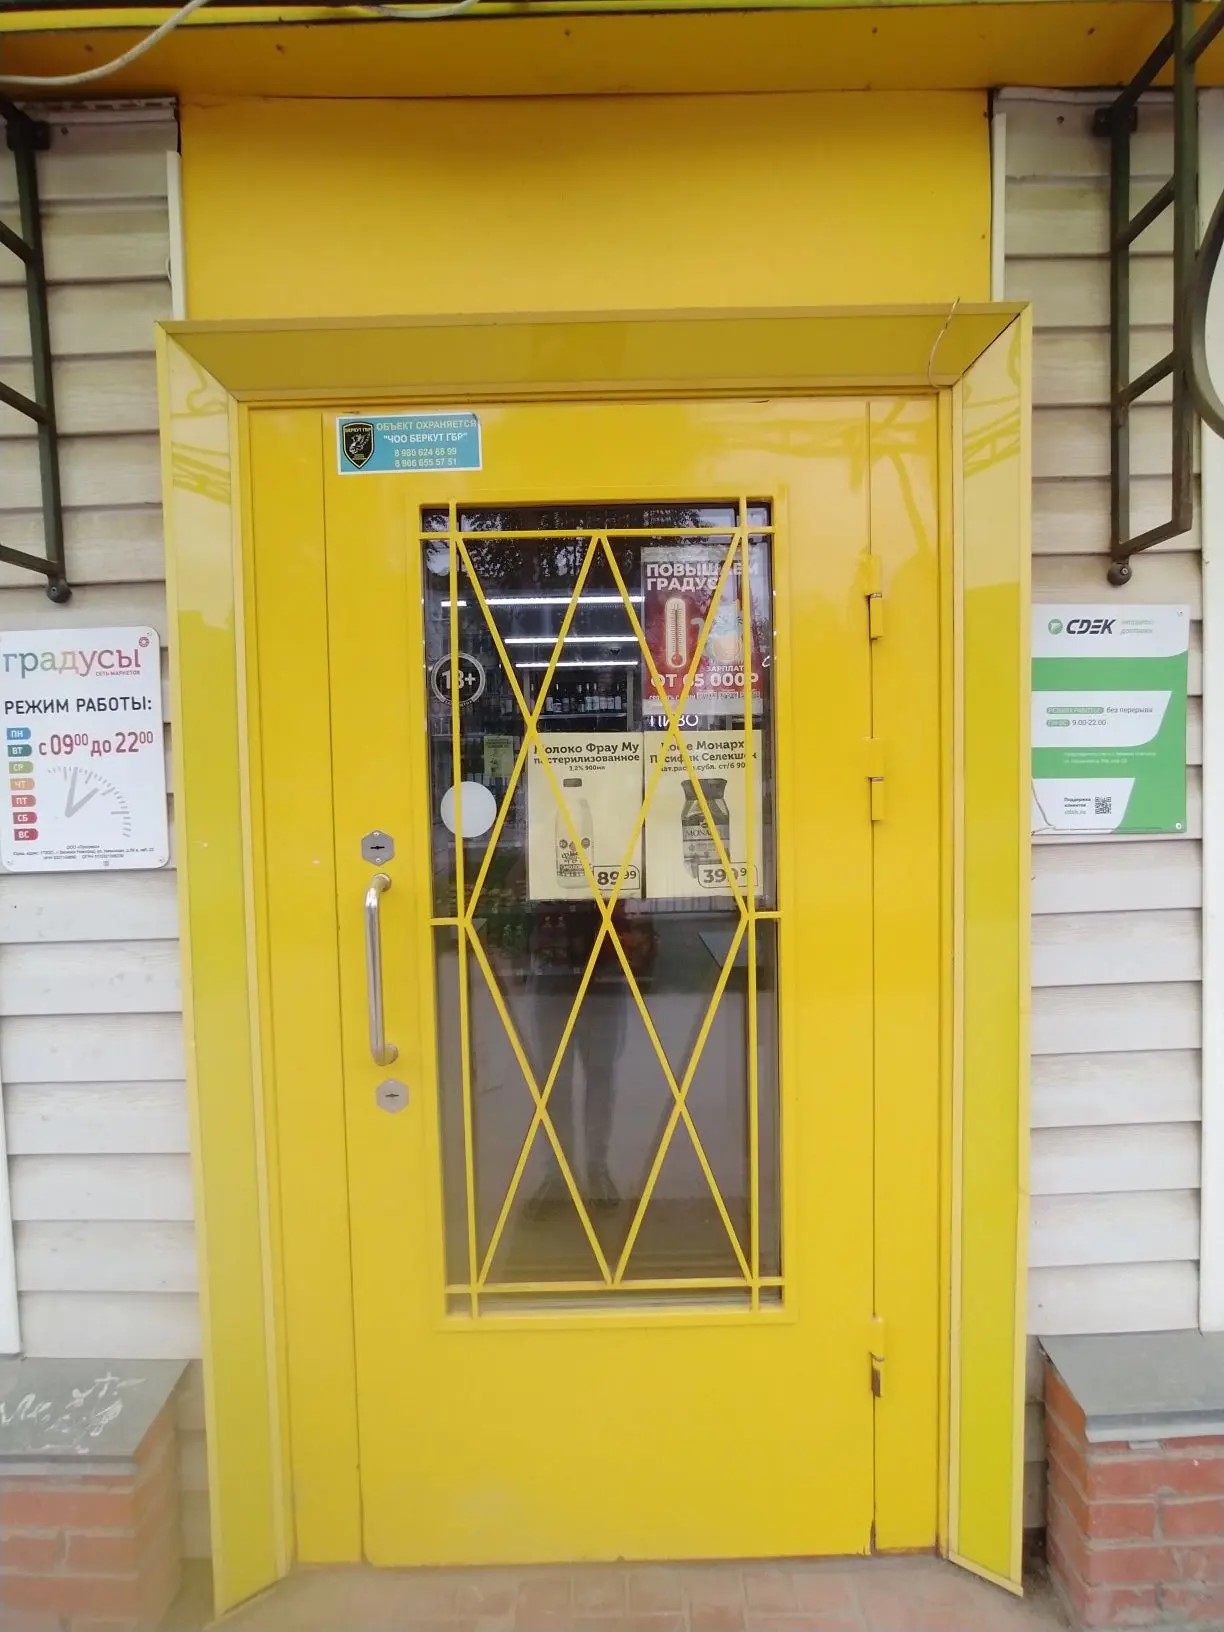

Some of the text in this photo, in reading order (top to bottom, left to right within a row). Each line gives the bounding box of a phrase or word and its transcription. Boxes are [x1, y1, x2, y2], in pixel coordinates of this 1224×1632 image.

[376, 419, 477, 431] ОБЪЕКТ ОХРАНЯЕТСЯ
[383, 431, 468, 444] "ЧОО БЕРКУТ ГБР"
[447, 457, 457, 466] 51
[646, 562, 760, 577] ПОВЫШЕМ
[1066, 619, 1117, 635] CDEK
[3, 648, 141, 679] градусы
[651, 673, 678, 688] ОТ
[4, 696, 152, 715] РЕЖИМ РАБОТЫ:
[10, 730, 23, 738] ПН
[12, 746, 23, 755] ВТ
[90, 739, 112, 757] до
[586, 742, 618, 755] Фрау
[621, 741, 640, 753] Му
[696, 740, 745, 751] Монарх
[13, 763, 23, 772] СР
[15, 780, 26, 789] ЧТ
[16, 797, 27, 805] ПТ
[17, 814, 29, 822] СБ
[18, 831, 30, 839] ВС
